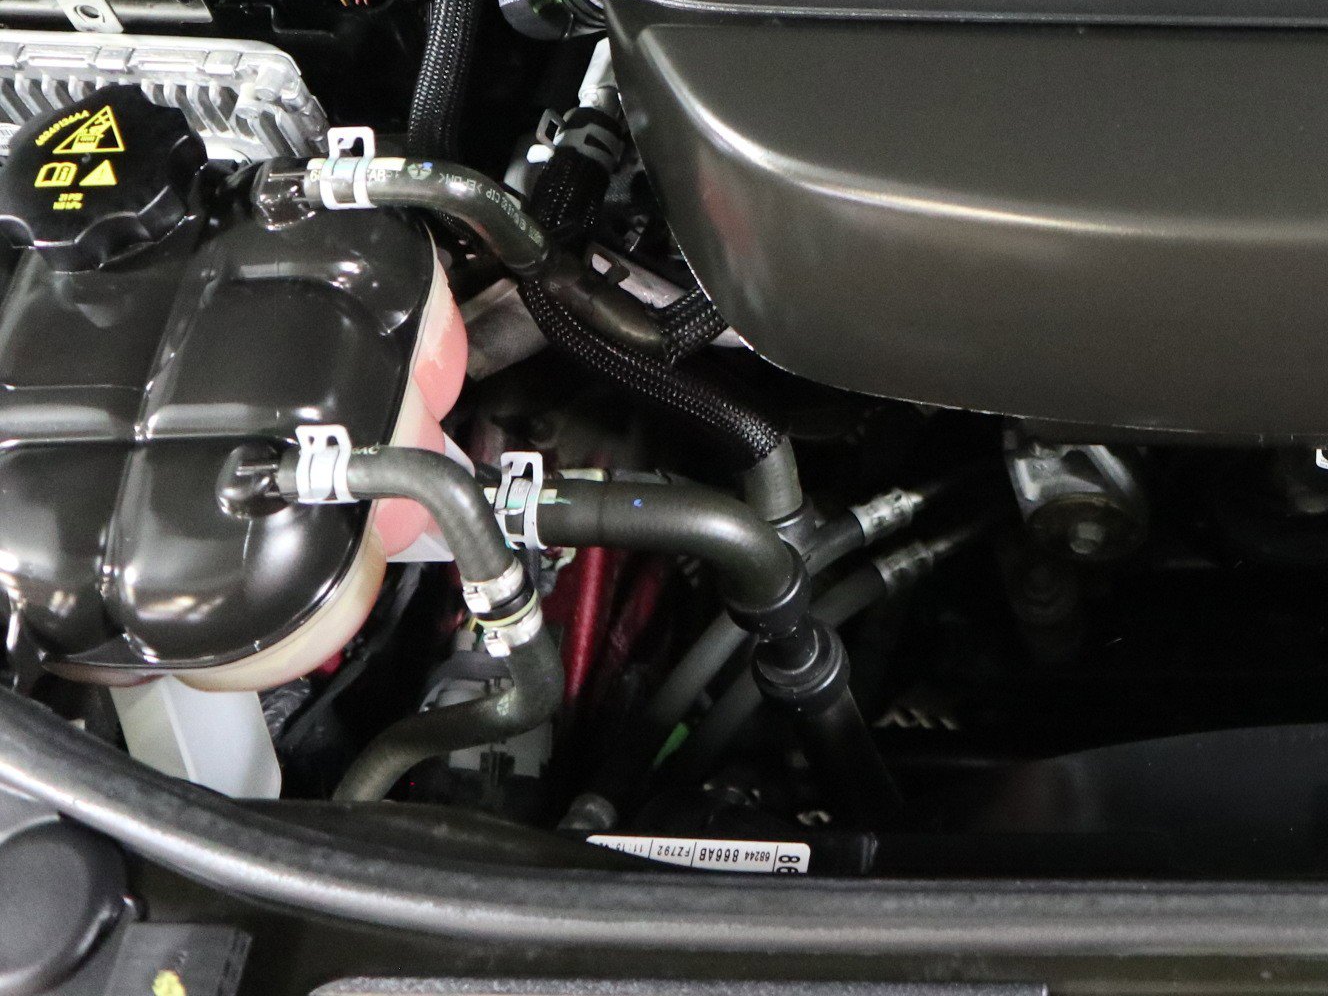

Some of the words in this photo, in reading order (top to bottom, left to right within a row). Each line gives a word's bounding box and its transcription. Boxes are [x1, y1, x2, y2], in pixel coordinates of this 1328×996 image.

[656, 844, 691, 857] FZ792
[698, 848, 740, 863] 866AB
[743, 850, 771, 863] 68244
